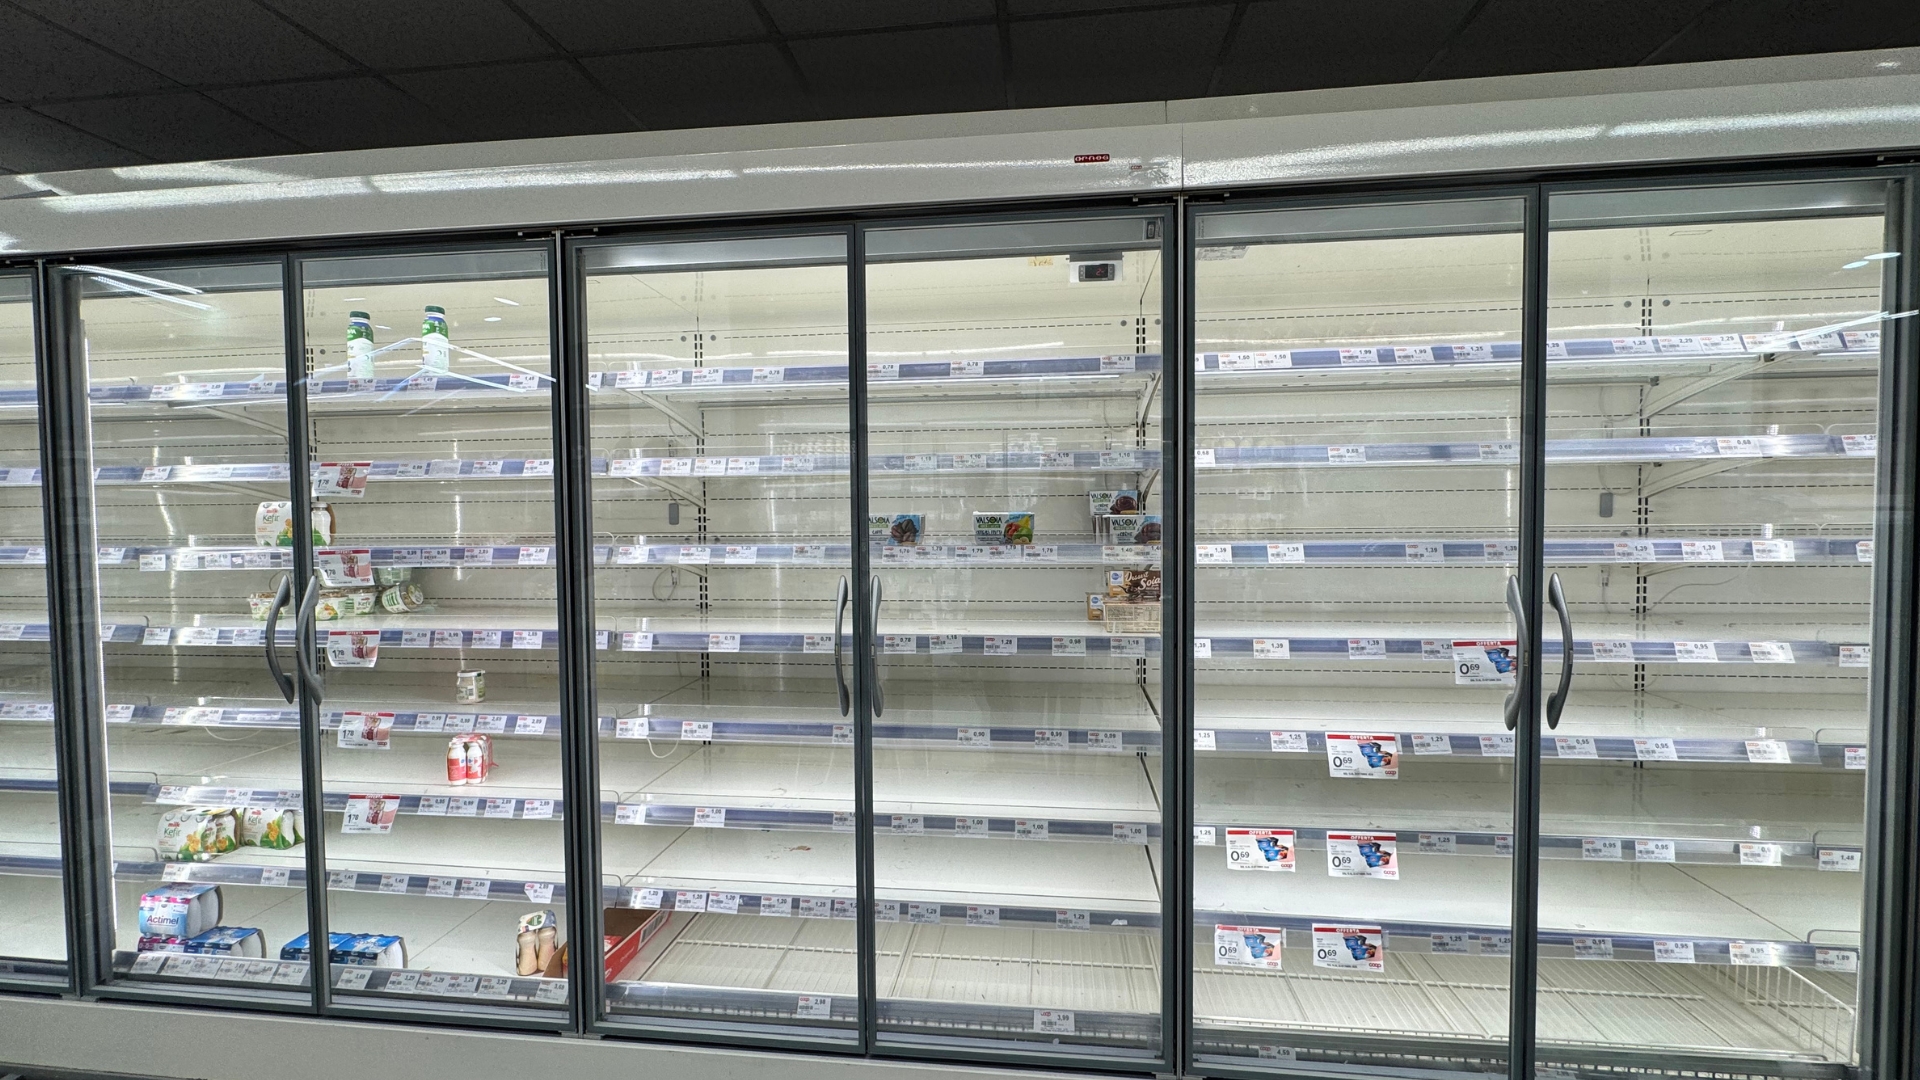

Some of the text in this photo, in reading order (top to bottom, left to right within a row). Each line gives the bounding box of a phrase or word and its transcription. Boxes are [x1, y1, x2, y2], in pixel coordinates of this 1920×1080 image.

[263, 514, 279, 522] Kefir
[1125, 572, 1149, 581] Dessert
[1138, 576, 1161, 590] Soia
[248, 815, 262, 824] Kefir
[164, 828, 182, 838] Kefir
[147, 915, 179, 926] Actimel
